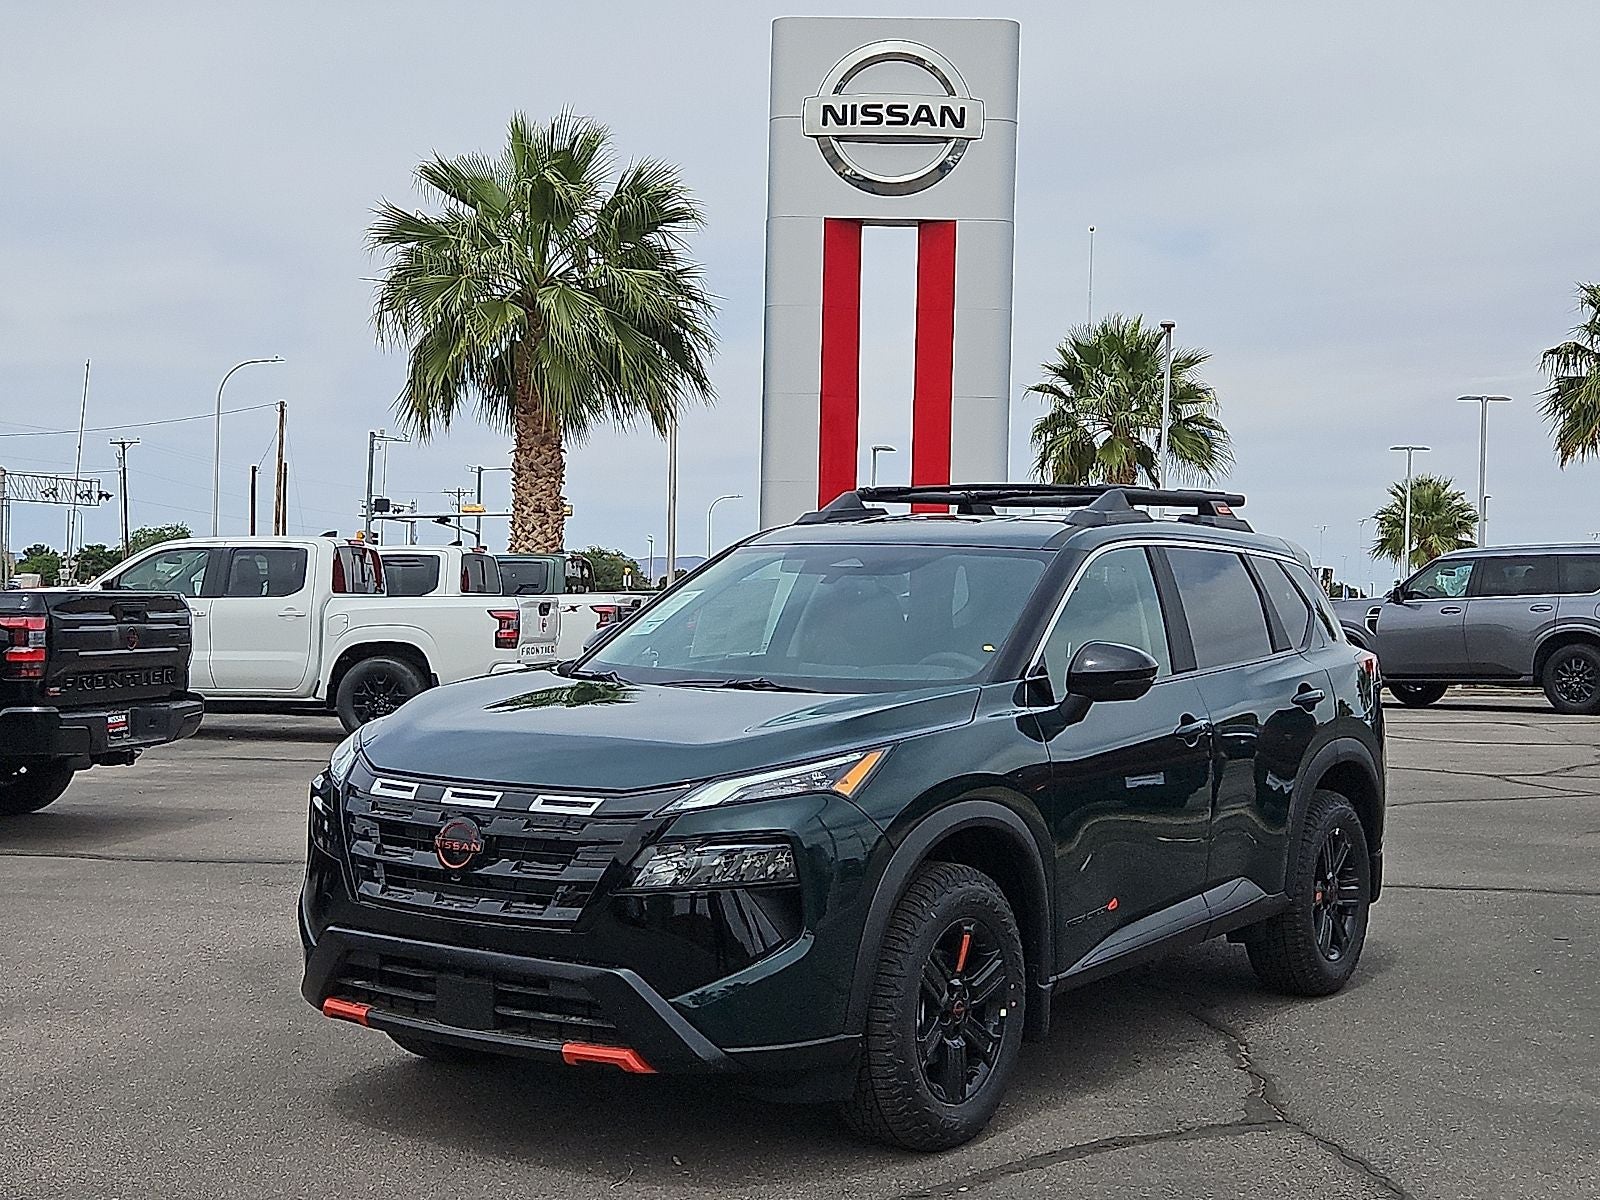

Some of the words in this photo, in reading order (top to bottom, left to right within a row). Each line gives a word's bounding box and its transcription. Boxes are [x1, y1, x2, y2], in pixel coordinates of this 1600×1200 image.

[821, 103, 966, 128] NISSAN
[521, 645, 555, 656] FRONTIER
[61, 669, 176, 691] FRONTIER
[435, 838, 481, 852] NISSAN
